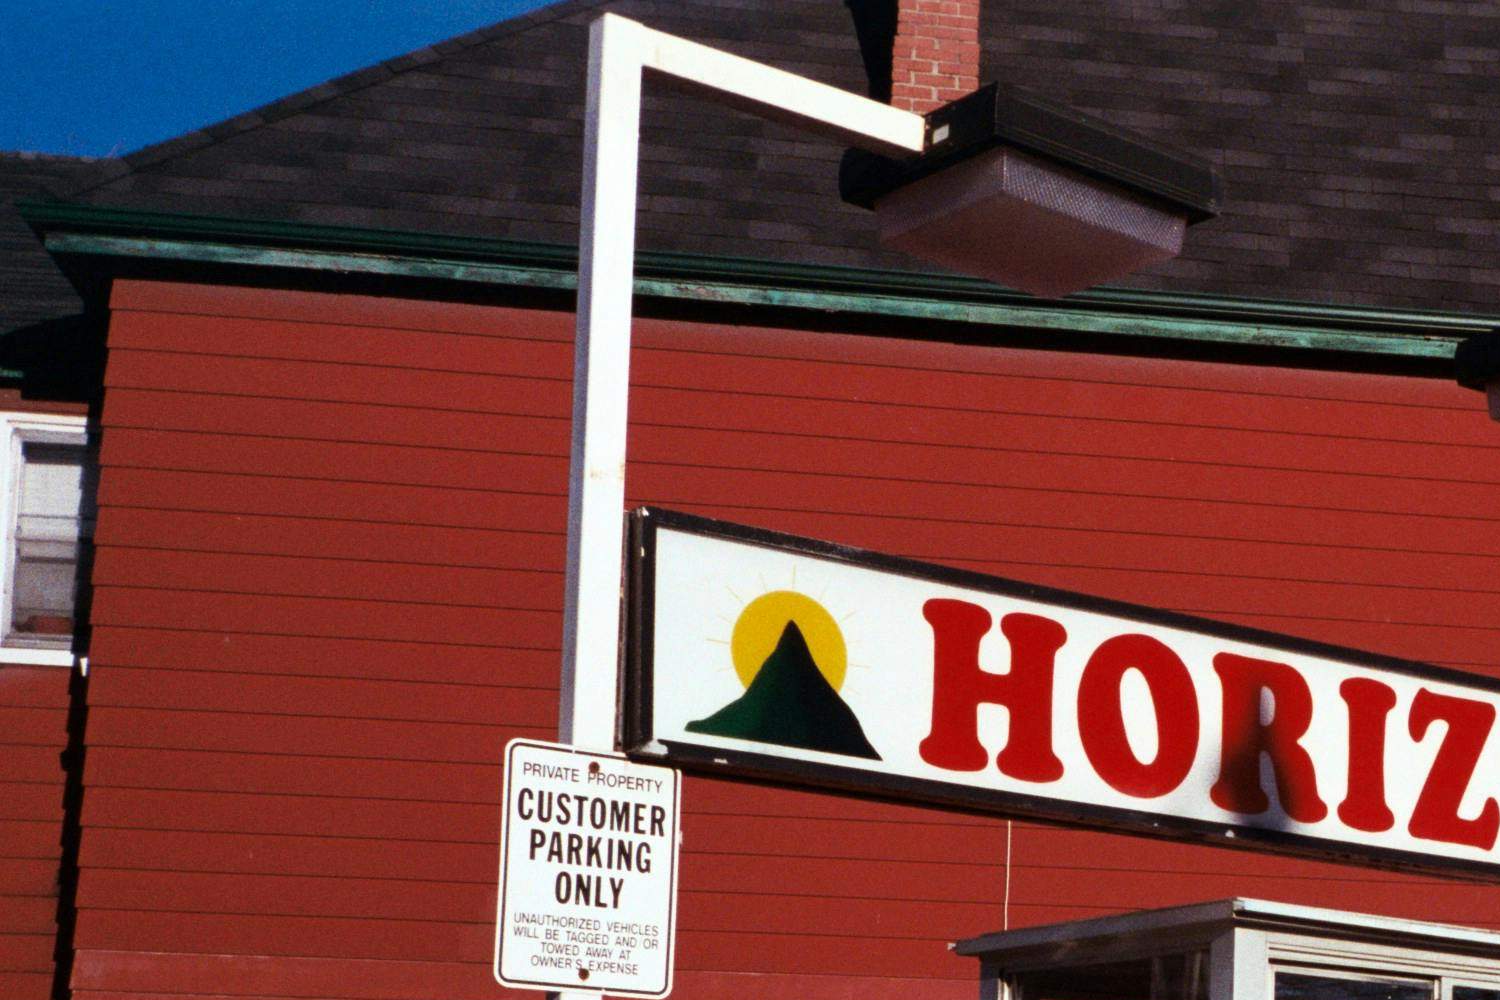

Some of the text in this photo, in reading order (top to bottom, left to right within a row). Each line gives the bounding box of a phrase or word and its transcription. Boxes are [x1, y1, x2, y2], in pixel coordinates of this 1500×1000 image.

[522, 761, 663, 794] PRIVATE PROPERTY
[517, 787, 666, 837] CUSTOMER
[529, 828, 652, 874] PARKING
[554, 871, 625, 910] ONLY
[513, 912, 660, 937] UNAUTHORIZED VEHICLES
[513, 926, 660, 950] WILL BE TAGGED AND OR
[540, 942, 632, 961] TOWED AWAY AT
[588, 960, 639, 976] EXPENSE
